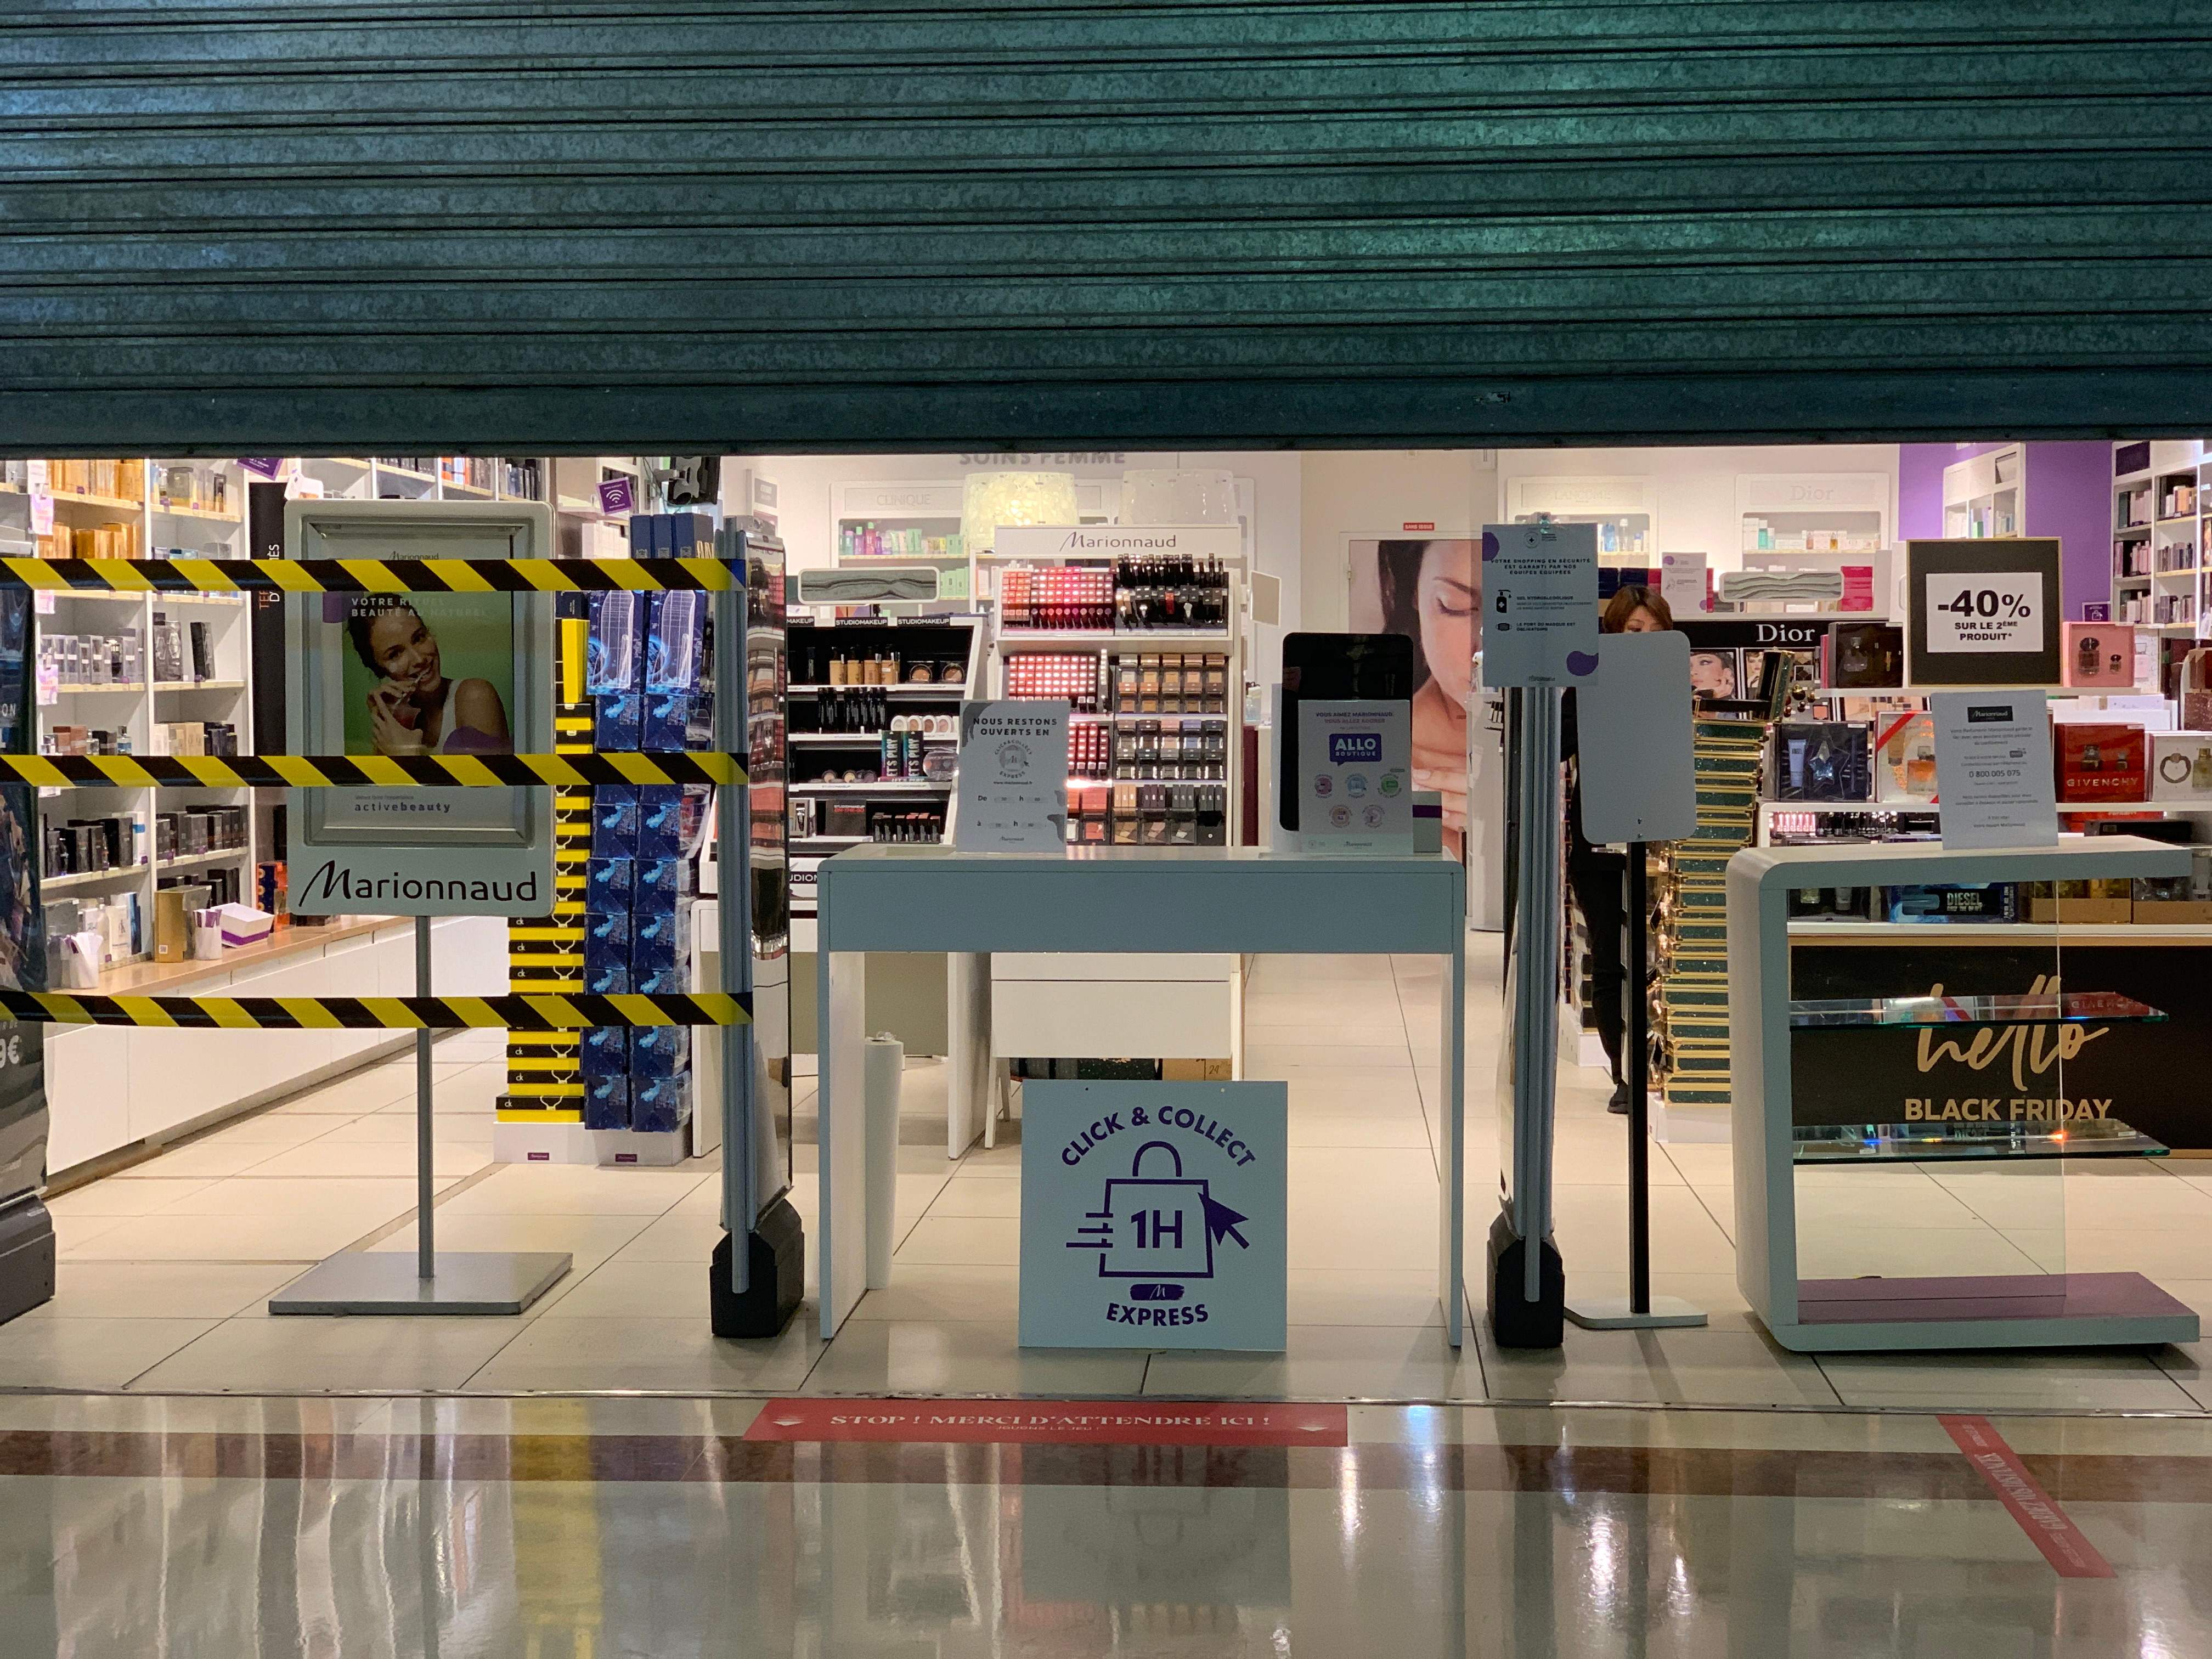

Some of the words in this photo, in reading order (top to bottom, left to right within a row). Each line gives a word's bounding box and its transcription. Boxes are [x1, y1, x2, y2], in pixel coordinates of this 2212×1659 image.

[877, 494, 931, 505] CLINIQUE
[1790, 486, 1833, 500] Dior
[1059, 531, 1176, 551] Marionnaud
[351, 607, 402, 616] BEAUTÉ
[1938, 590, 2030, 617] -40%
[1756, 624, 1815, 641] Dior
[1335, 738, 1376, 751] ALLO
[2067, 777, 2138, 787] GIVENCHY
[355, 802, 450, 813] activebeauty
[299, 860, 537, 907] Marionnaud
[1947, 893, 1980, 906] DIESEL
[1917, 974, 2109, 1091] hello
[1905, 1098, 2001, 1121] BLACK
[2010, 1098, 2112, 1121] FRIDAY
[1062, 1111, 1125, 1166] CLICK
[1131, 1106, 1151, 1126] &
[1158, 1105, 1256, 1167] COLLECT
[1131, 1209, 1182, 1249] 1H
[1106, 1302, 1209, 1327] EXPRESS
[830, 1415, 905, 1424] STOP
[913, 1415, 921, 1424] !
[929, 1415, 1021, 1424] MERCI
[1030, 1416, 1211, 1425] D'ATTENDRE
[1221, 1417, 1254, 1425] ICI
[1263, 1417, 1269, 1425] !
